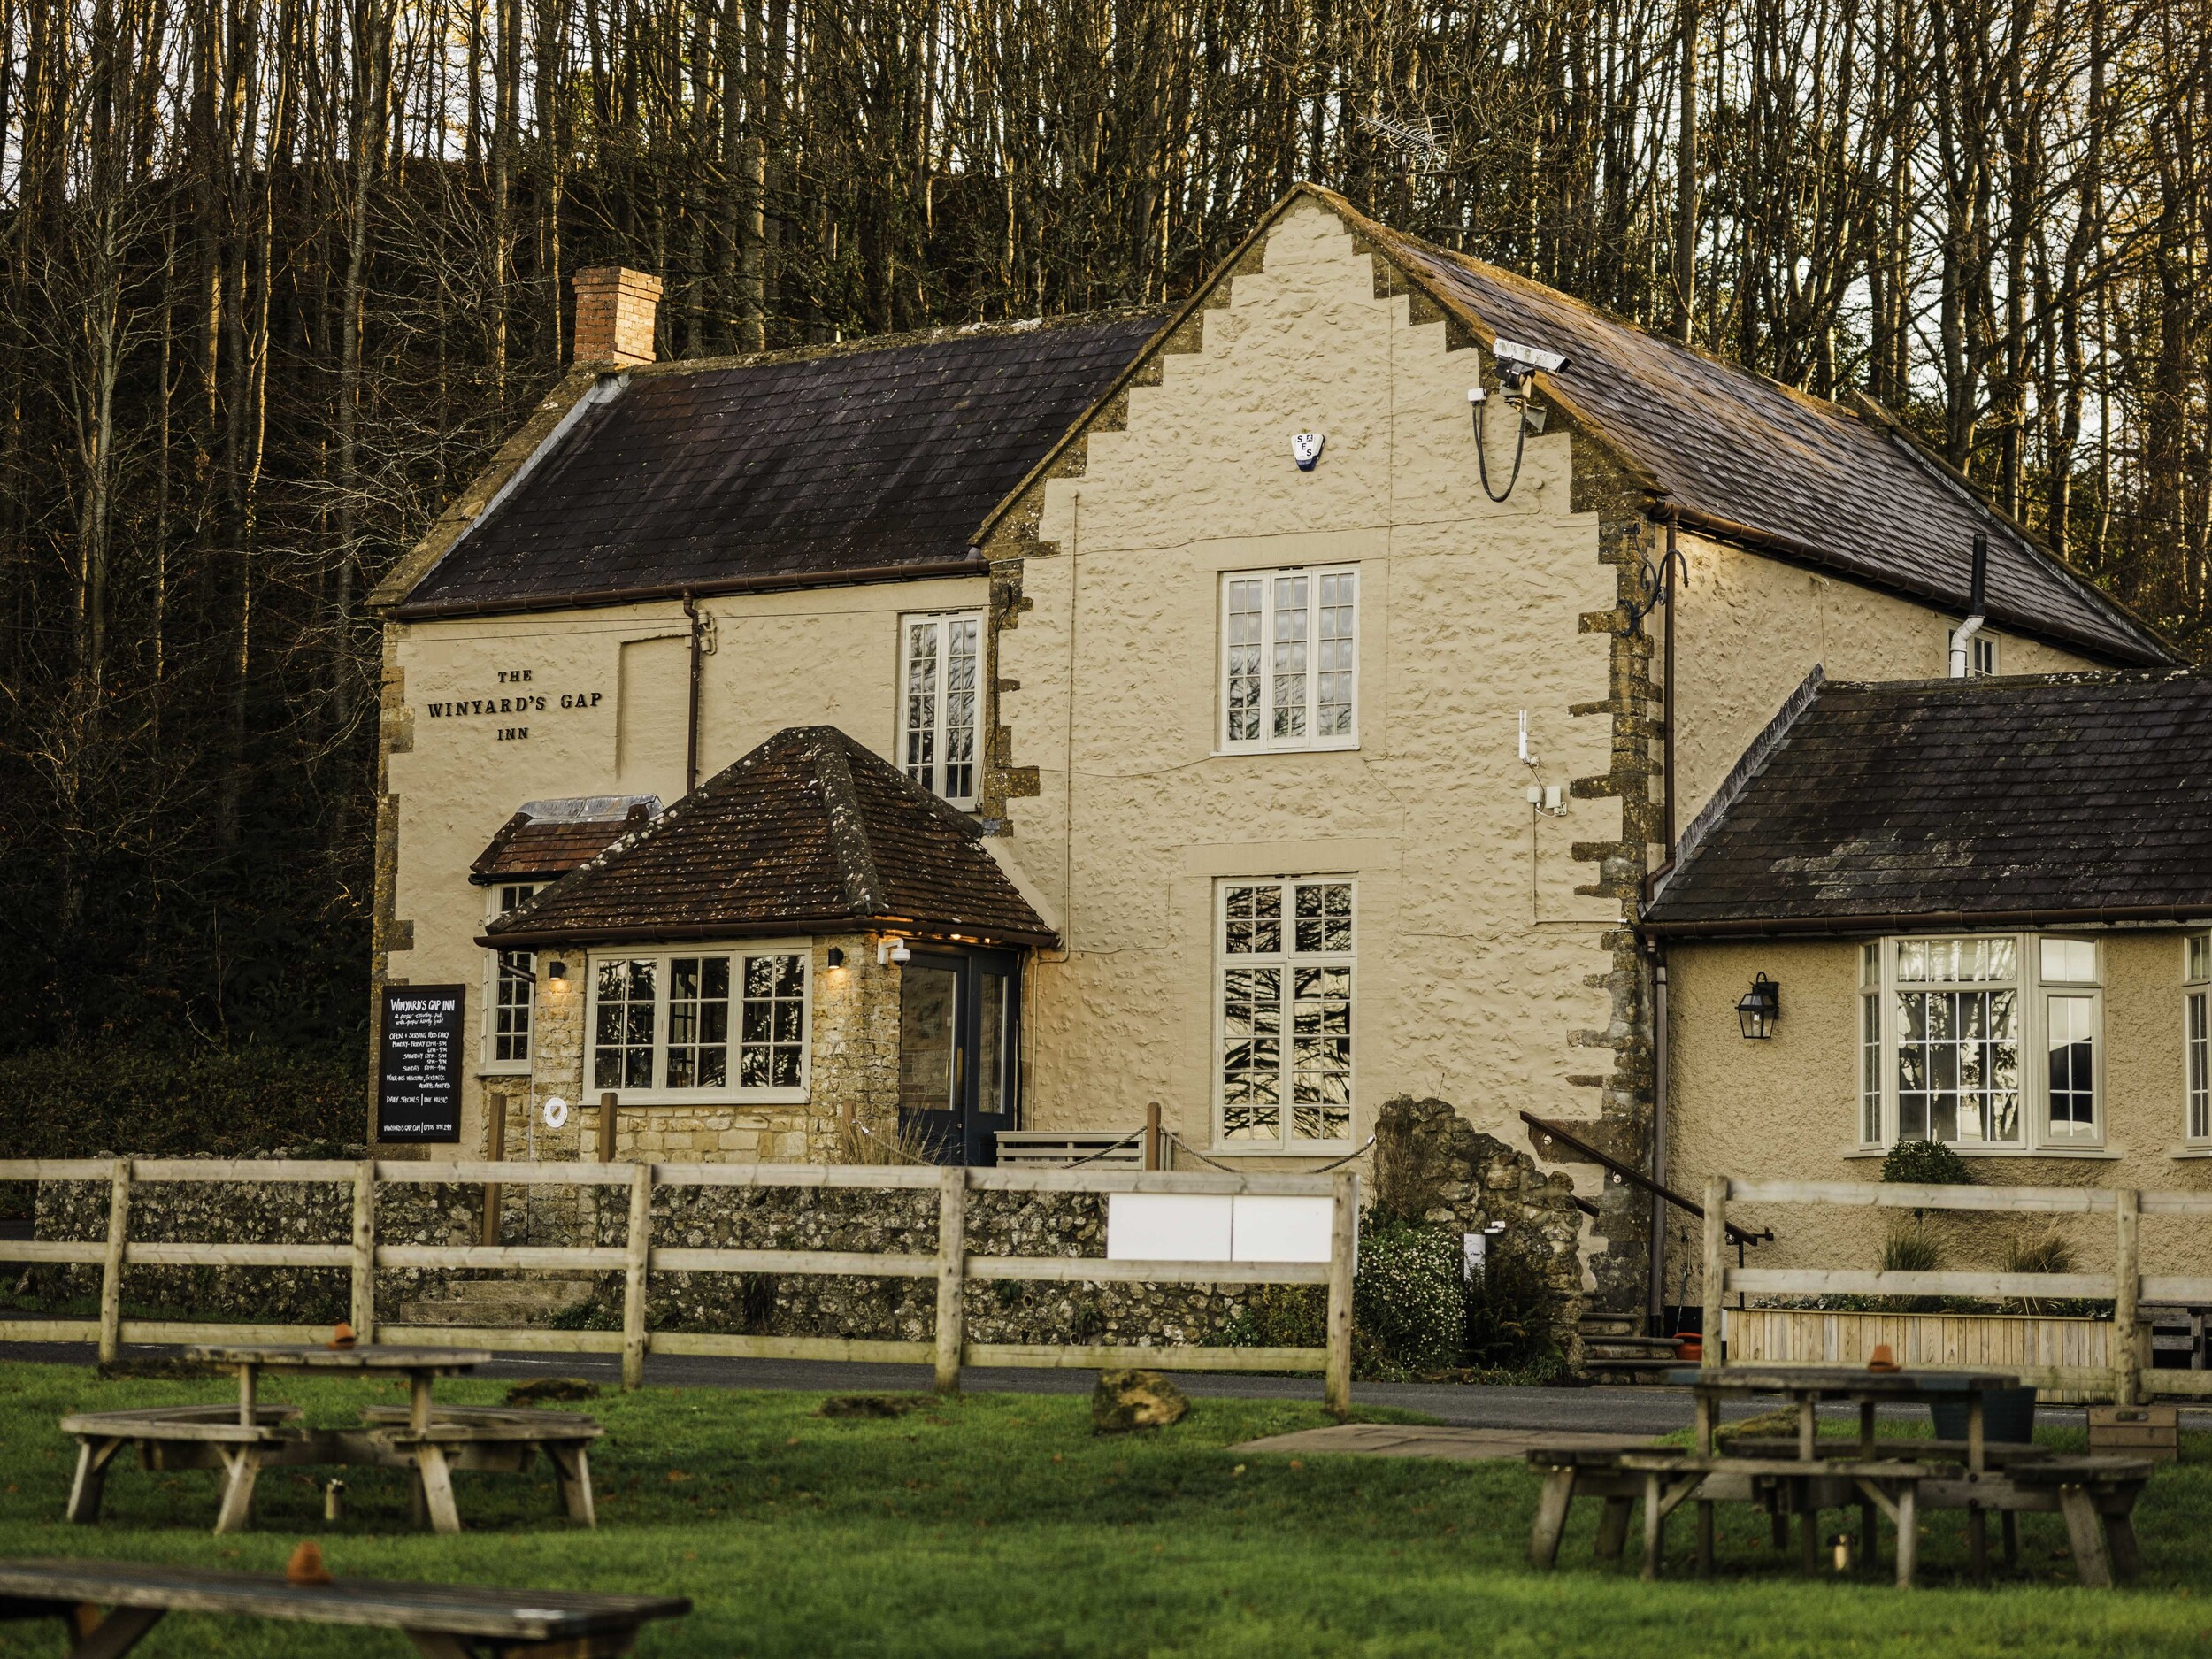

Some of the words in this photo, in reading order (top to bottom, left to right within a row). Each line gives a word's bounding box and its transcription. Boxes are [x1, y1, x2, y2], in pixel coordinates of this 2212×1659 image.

[497, 670, 533, 683] THE
[428, 695, 547, 718] WINYARD'S
[560, 692, 603, 709] GAP
[497, 727, 529, 741] INN
[390, 998, 426, 1011] WINYARD'S
[428, 1000, 441, 1010] GAP
[442, 1000, 455, 1011] INN
